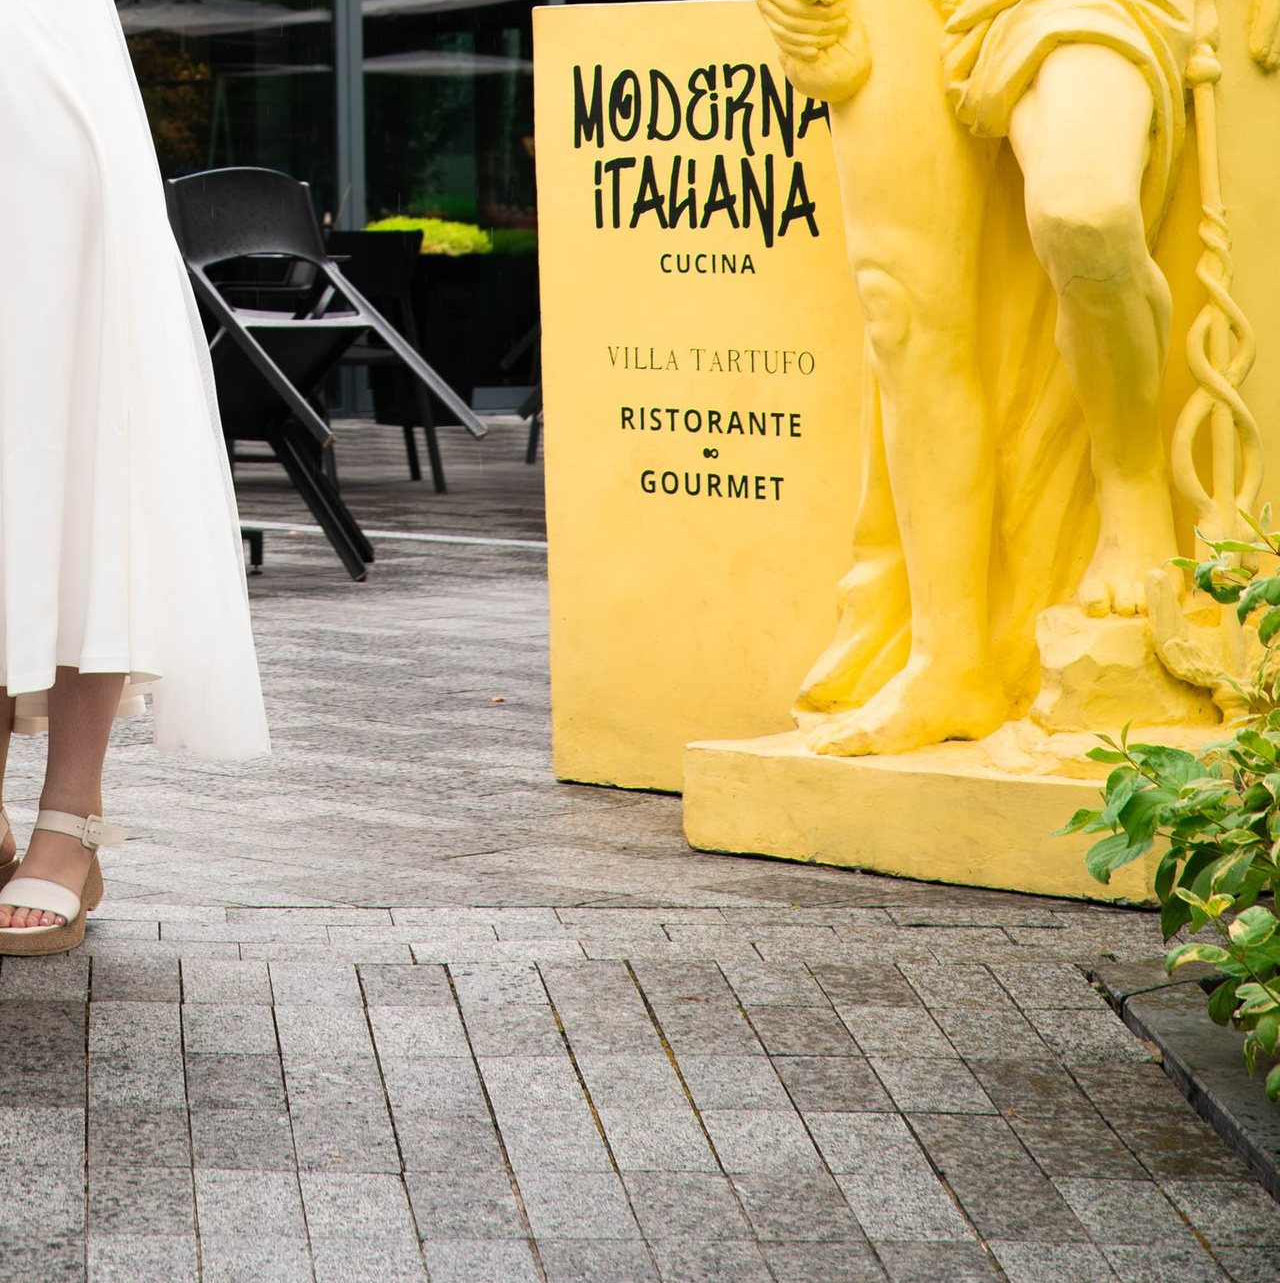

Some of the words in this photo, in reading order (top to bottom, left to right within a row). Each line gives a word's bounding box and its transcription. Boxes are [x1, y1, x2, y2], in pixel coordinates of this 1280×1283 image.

[660, 253, 756, 275] CUCINA
[607, 345, 679, 371] VILLA
[690, 347, 816, 376] TARTUFO
[620, 406, 802, 438] RISTORANTE
[640, 469, 785, 501] GOURMET
